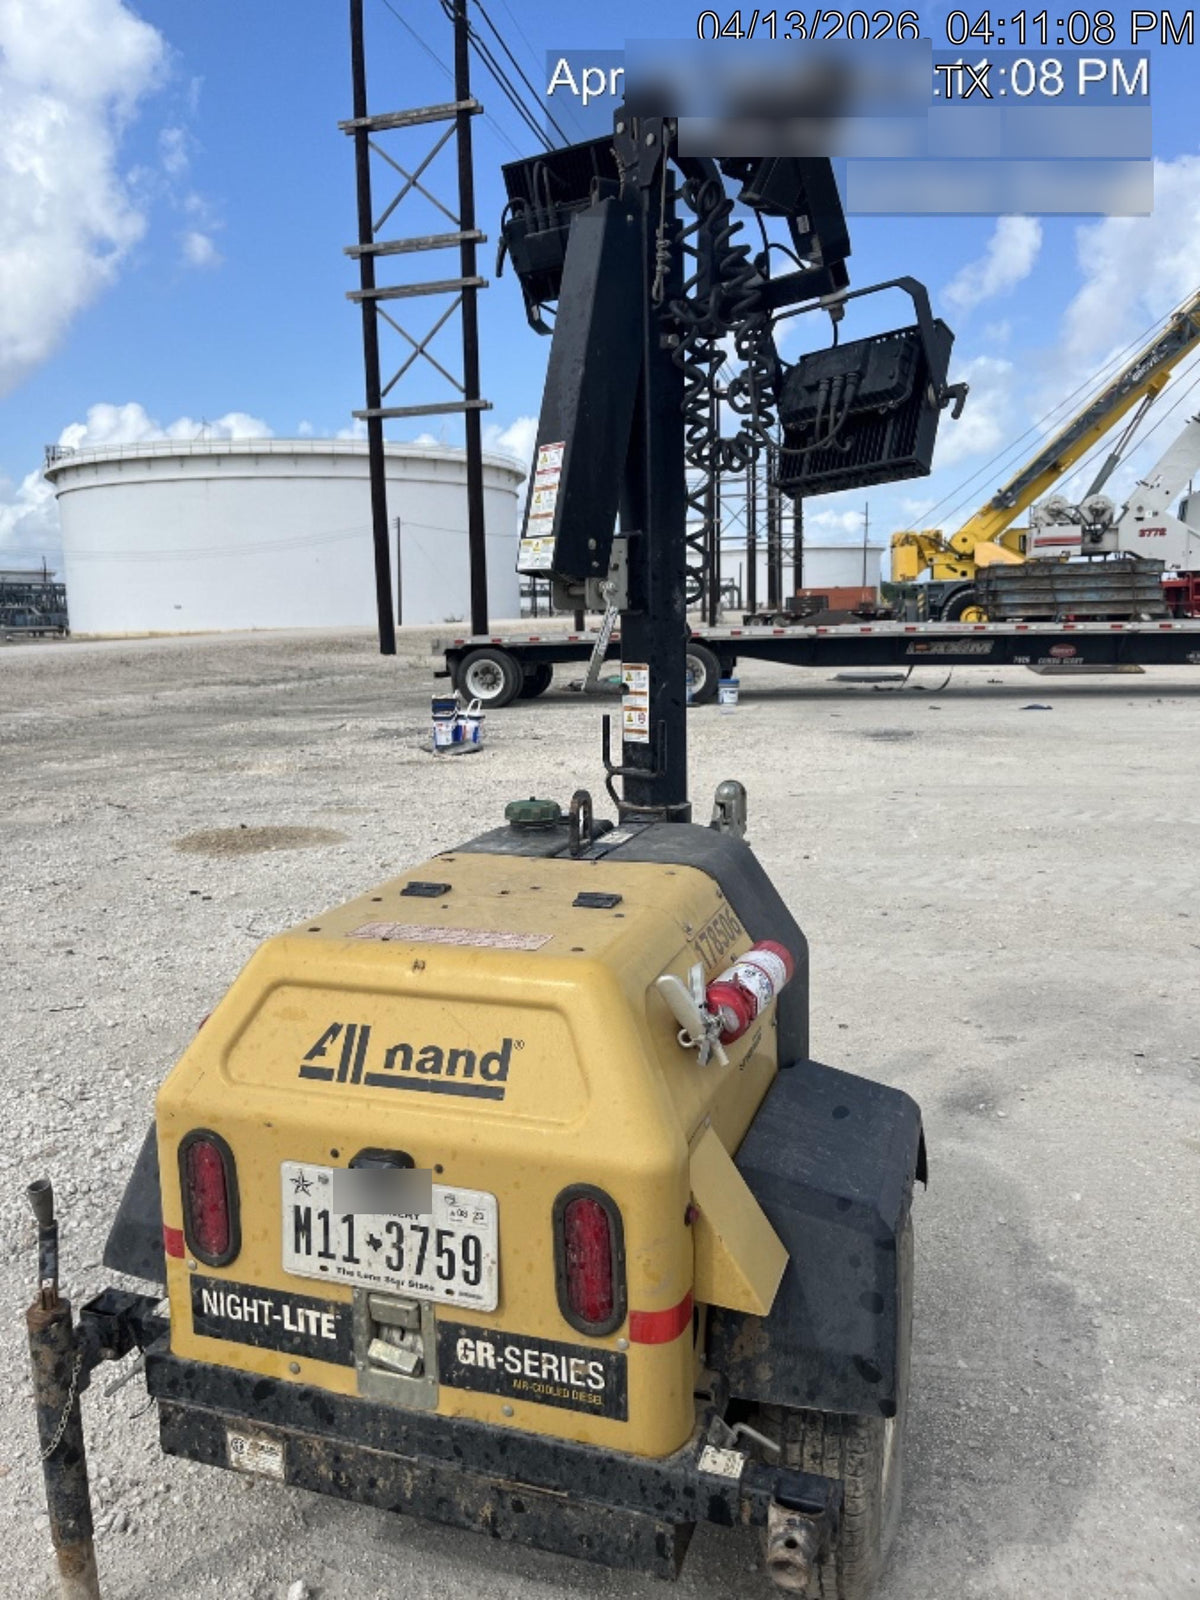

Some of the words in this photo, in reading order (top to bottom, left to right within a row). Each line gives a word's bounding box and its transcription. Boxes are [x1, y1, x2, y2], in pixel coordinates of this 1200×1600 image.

[385, 1220, 482, 1287] 3759
[202, 1288, 337, 1340] NIGHT-LITE
[456, 1338, 605, 1390] GR-SERIES
